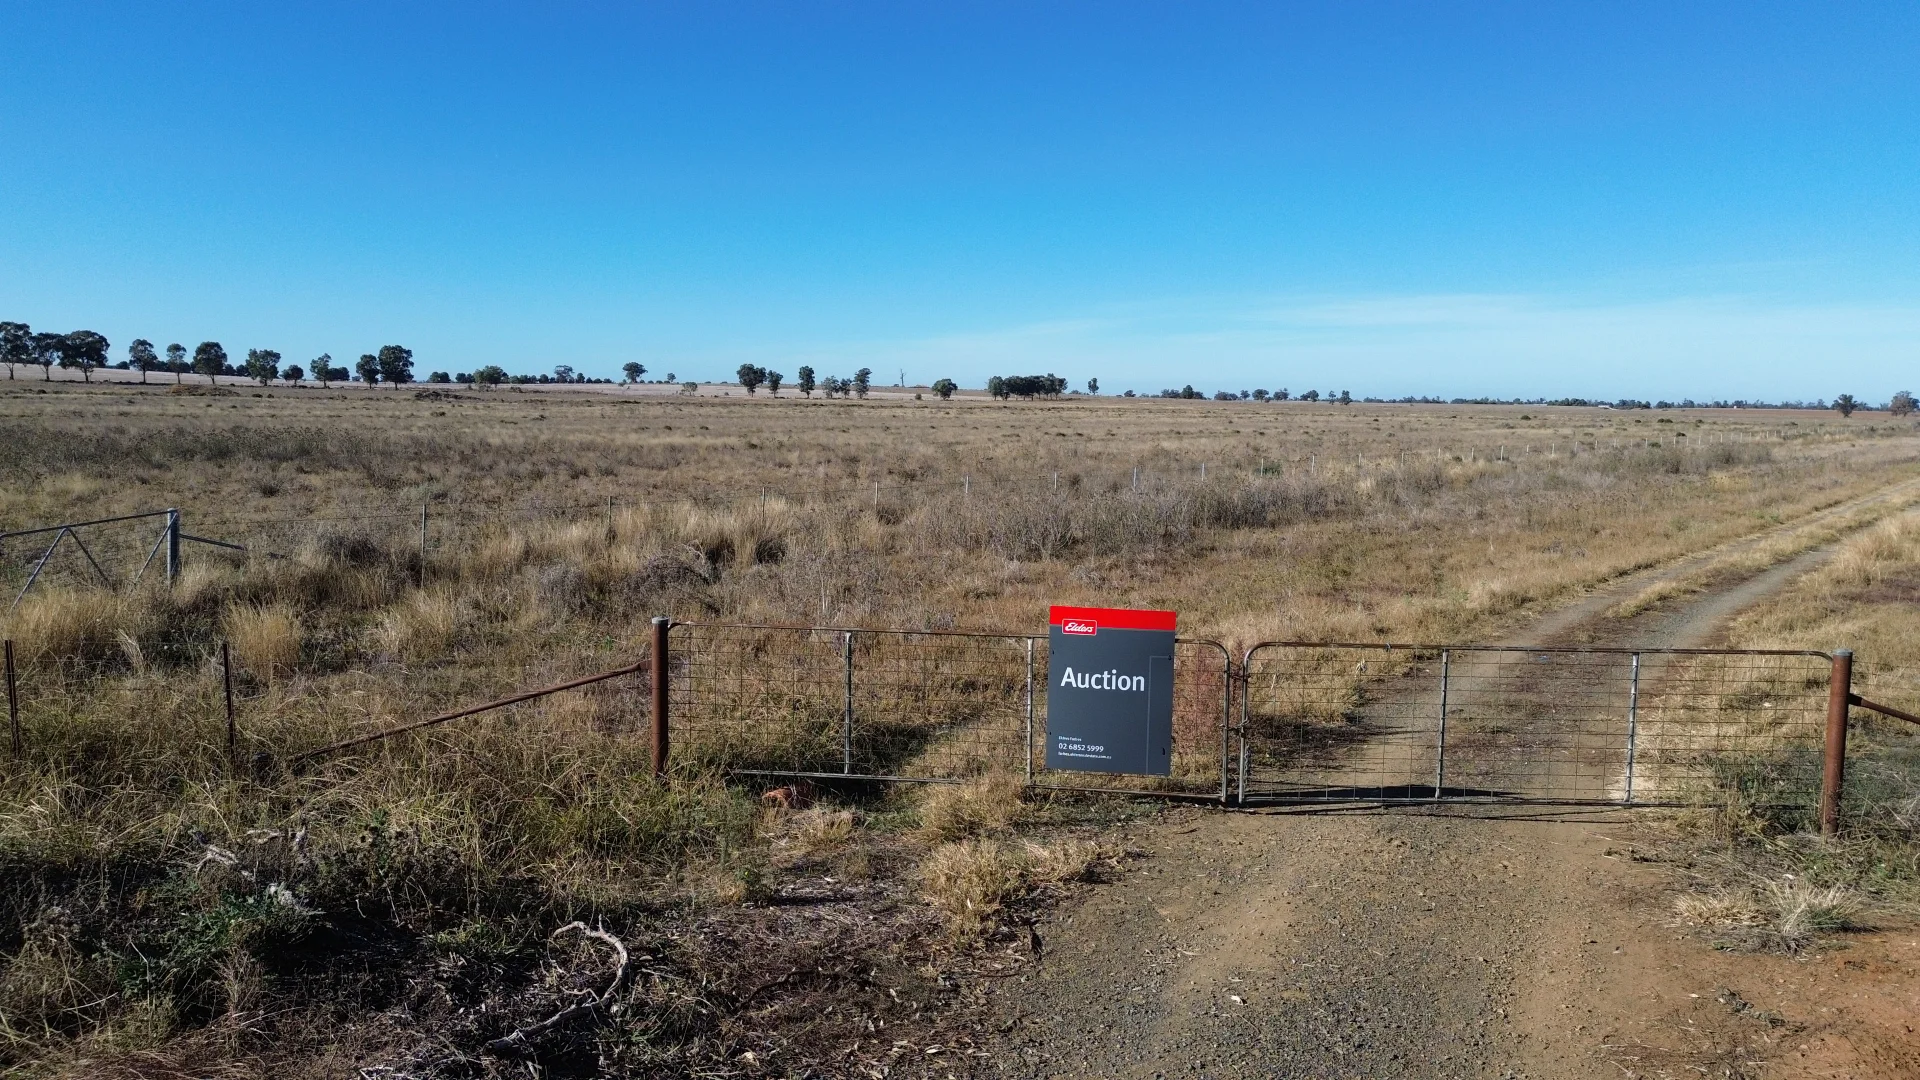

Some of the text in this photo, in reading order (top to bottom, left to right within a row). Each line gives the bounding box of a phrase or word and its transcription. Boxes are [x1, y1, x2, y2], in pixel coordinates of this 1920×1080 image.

[1065, 622, 1094, 633] Elders
[1060, 667, 1145, 692] Auction
[1068, 743, 1085, 751] 6852
